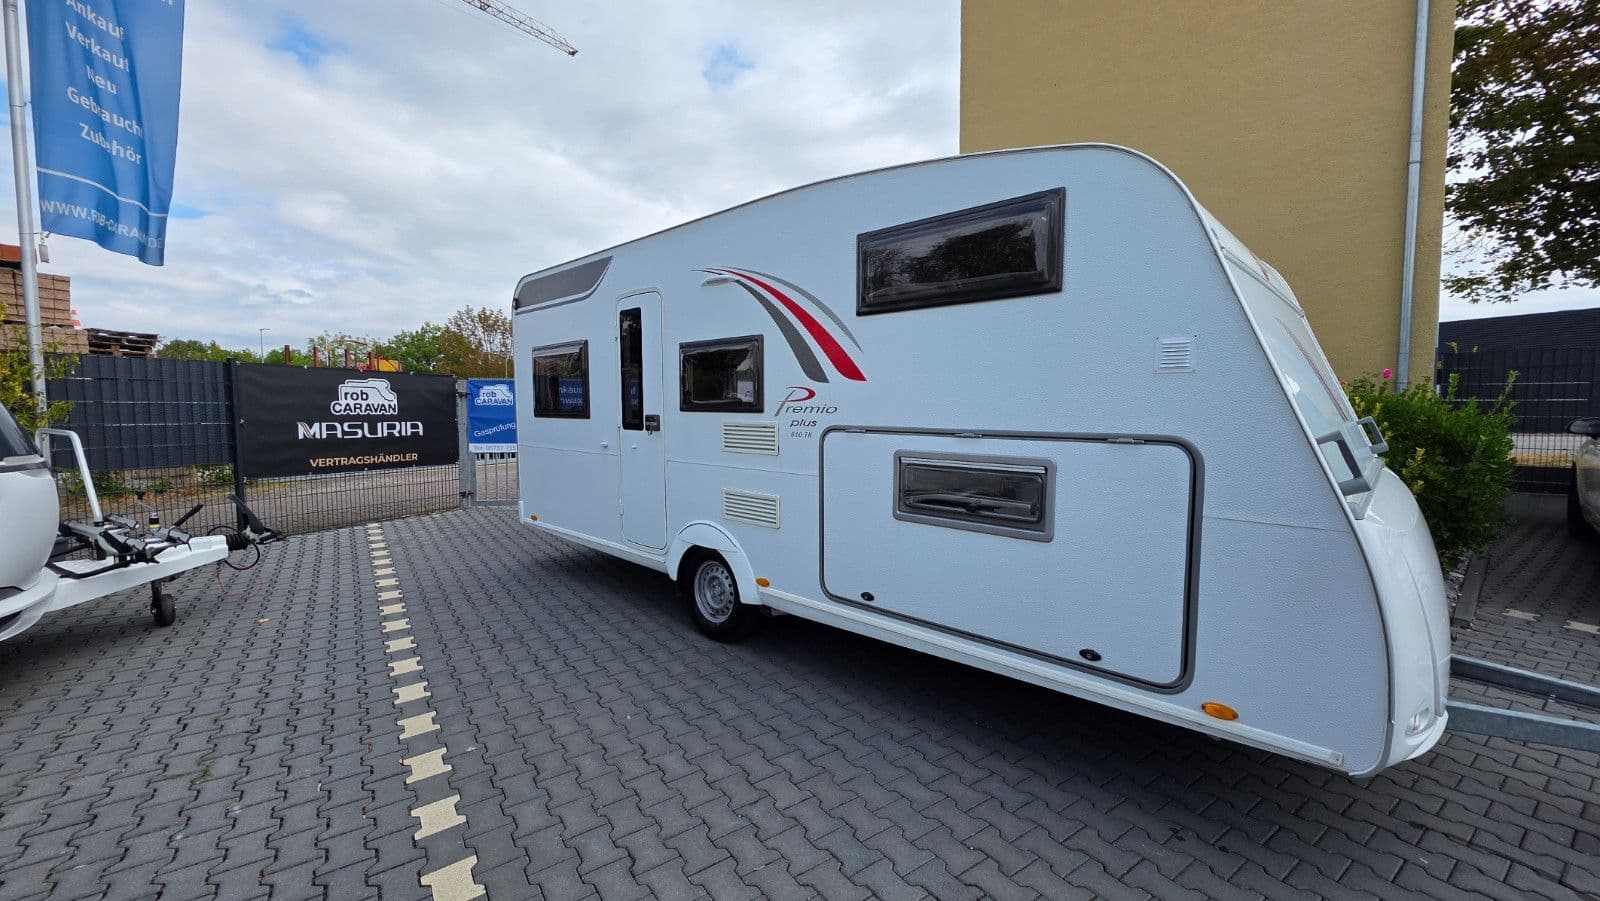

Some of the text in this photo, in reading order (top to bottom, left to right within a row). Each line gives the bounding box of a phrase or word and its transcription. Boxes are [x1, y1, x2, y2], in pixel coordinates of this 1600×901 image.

[67, 86, 143, 138] Gebauch
[344, 390, 368, 401] rob
[475, 397, 513, 405] CARAVAN
[775, 386, 838, 416] Premio
[332, 402, 397, 413] CARAVAN
[789, 419, 818, 427] plus
[296, 421, 424, 439] MASURIA
[310, 452, 418, 467] VERTRAGSHÄNDLER
